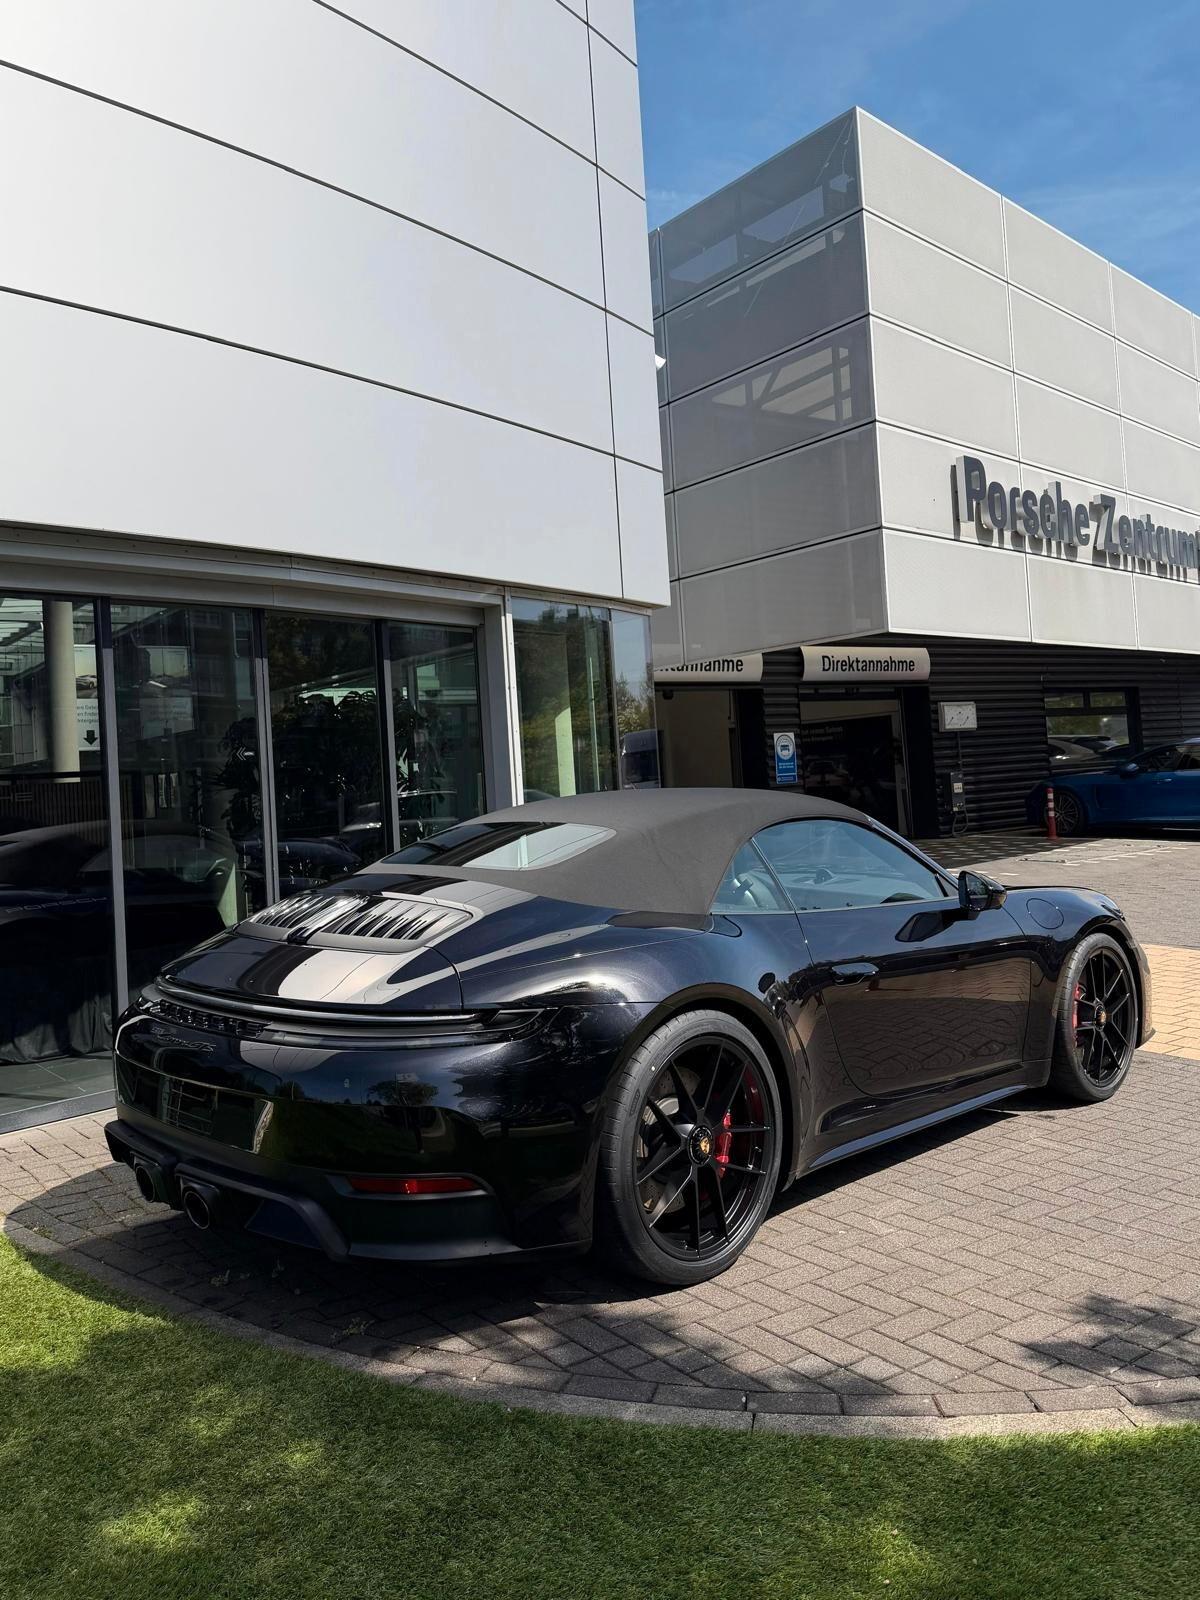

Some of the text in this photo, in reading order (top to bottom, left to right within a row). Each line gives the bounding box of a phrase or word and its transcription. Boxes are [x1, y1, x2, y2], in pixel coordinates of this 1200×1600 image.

[957, 455, 1090, 547] Porsche
[1095, 493, 1194, 568] Zentrum
[821, 655, 915, 672] Direktannahme
